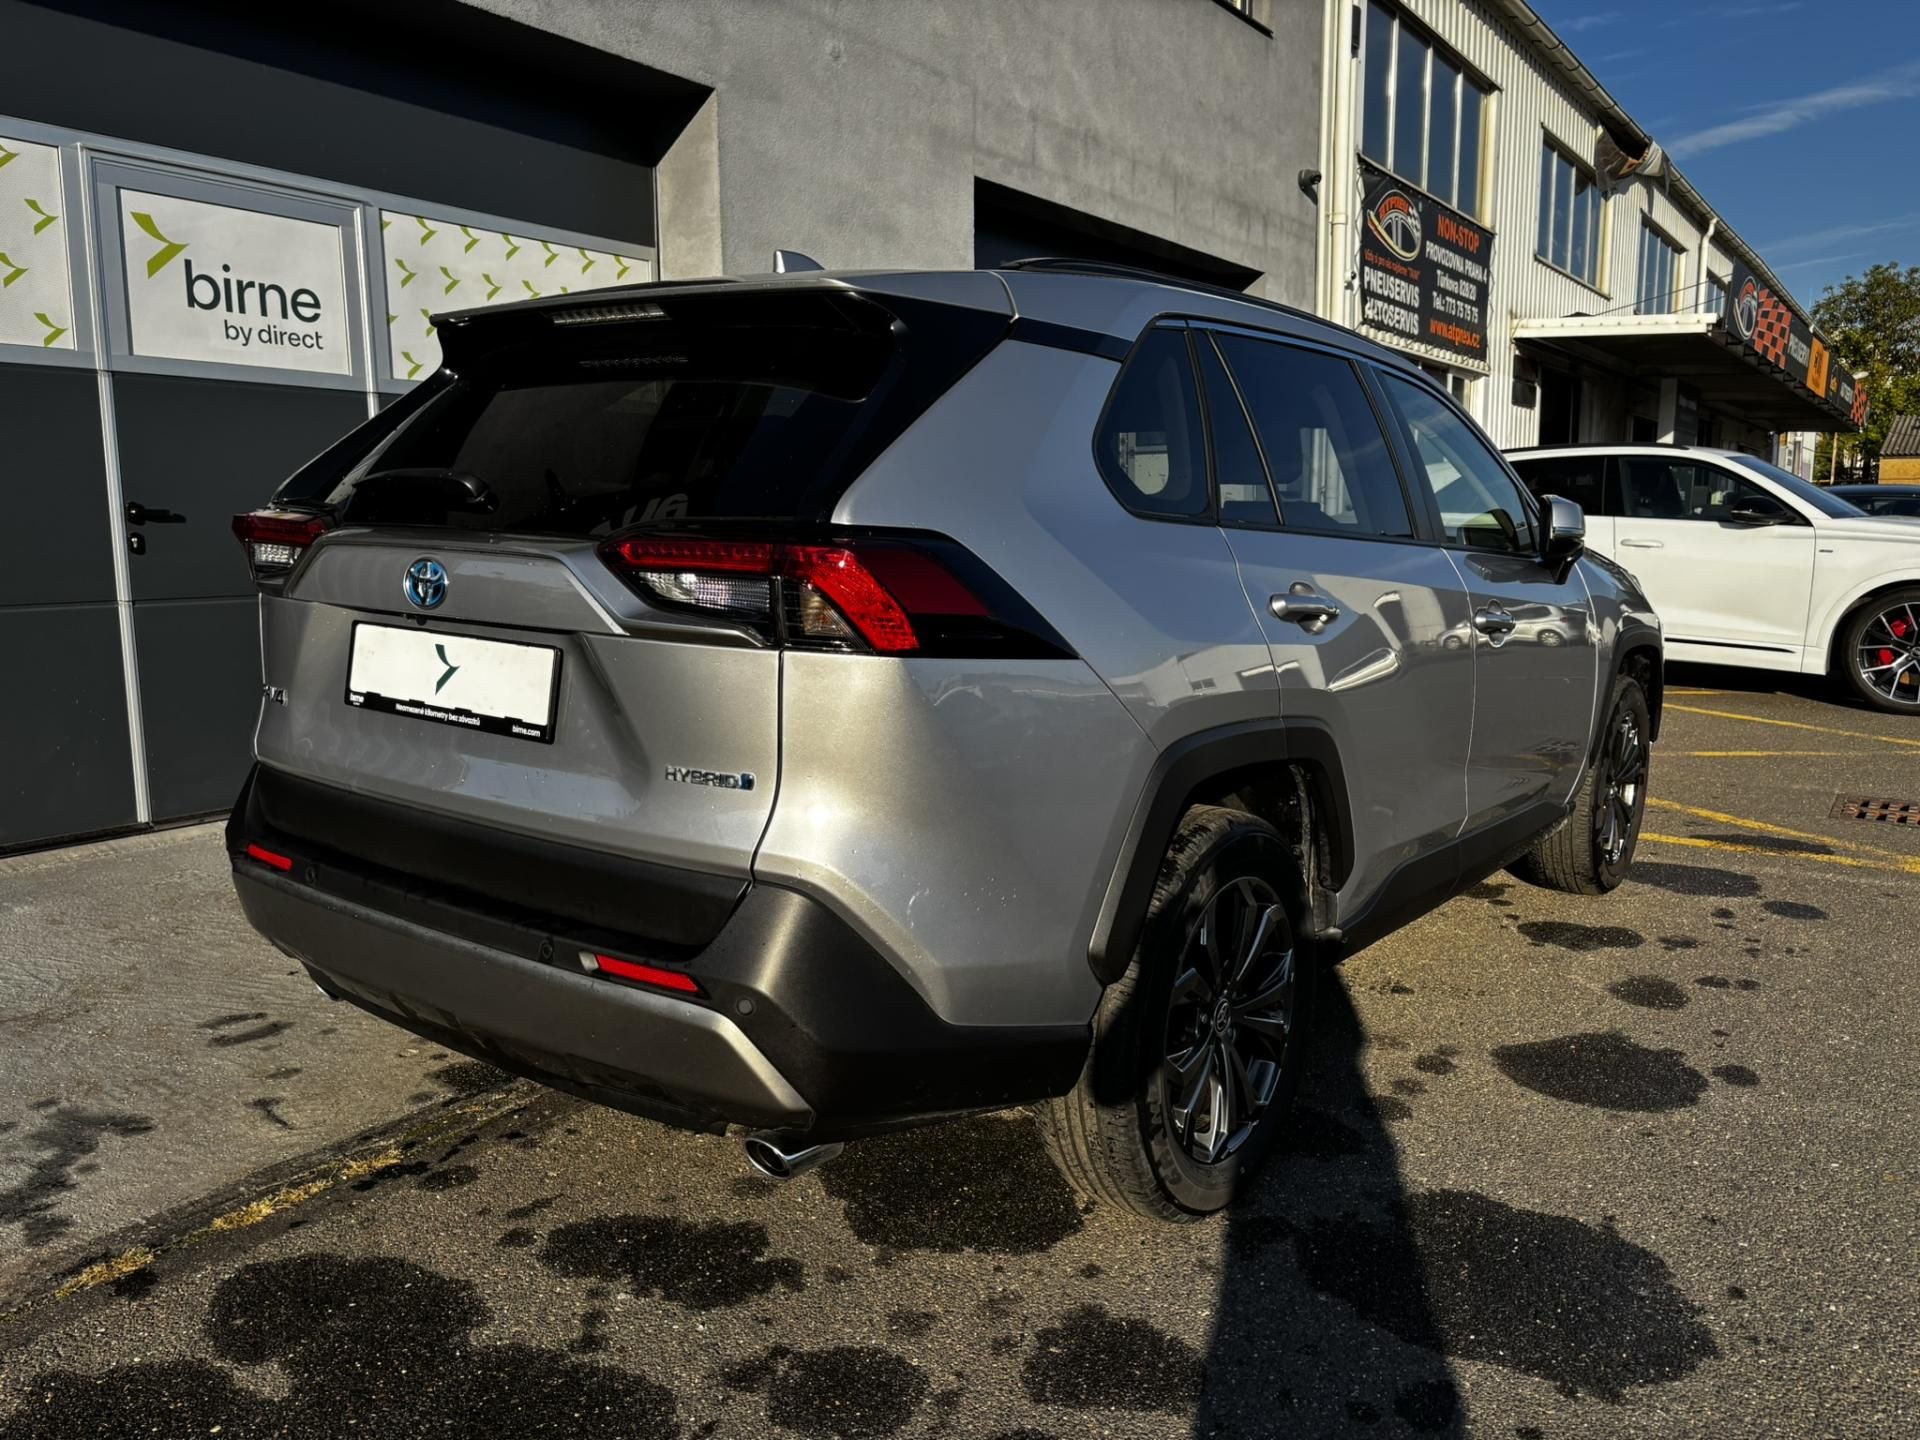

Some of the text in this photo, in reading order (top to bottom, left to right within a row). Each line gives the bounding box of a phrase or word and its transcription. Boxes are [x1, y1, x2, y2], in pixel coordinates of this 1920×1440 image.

[1437, 214, 1480, 254] NON-STOP
[1425, 240, 1465, 274] PROVOZOVNA
[1464, 259, 1483, 282] PRAHA
[1483, 268, 1488, 284] 4
[184, 259, 321, 323] birne
[1364, 265, 1420, 308] PNEUSERVIS
[1364, 296, 1420, 336] AUTOSERVIS
[1445, 296, 1456, 316] 773
[1456, 300, 1464, 318] 75
[1464, 303, 1471, 321] 75
[1471, 306, 1479, 323] 75
[224, 319, 324, 350] by direct
[512, 724, 541, 737] birne.com
[665, 766, 740, 789] HYBRID
